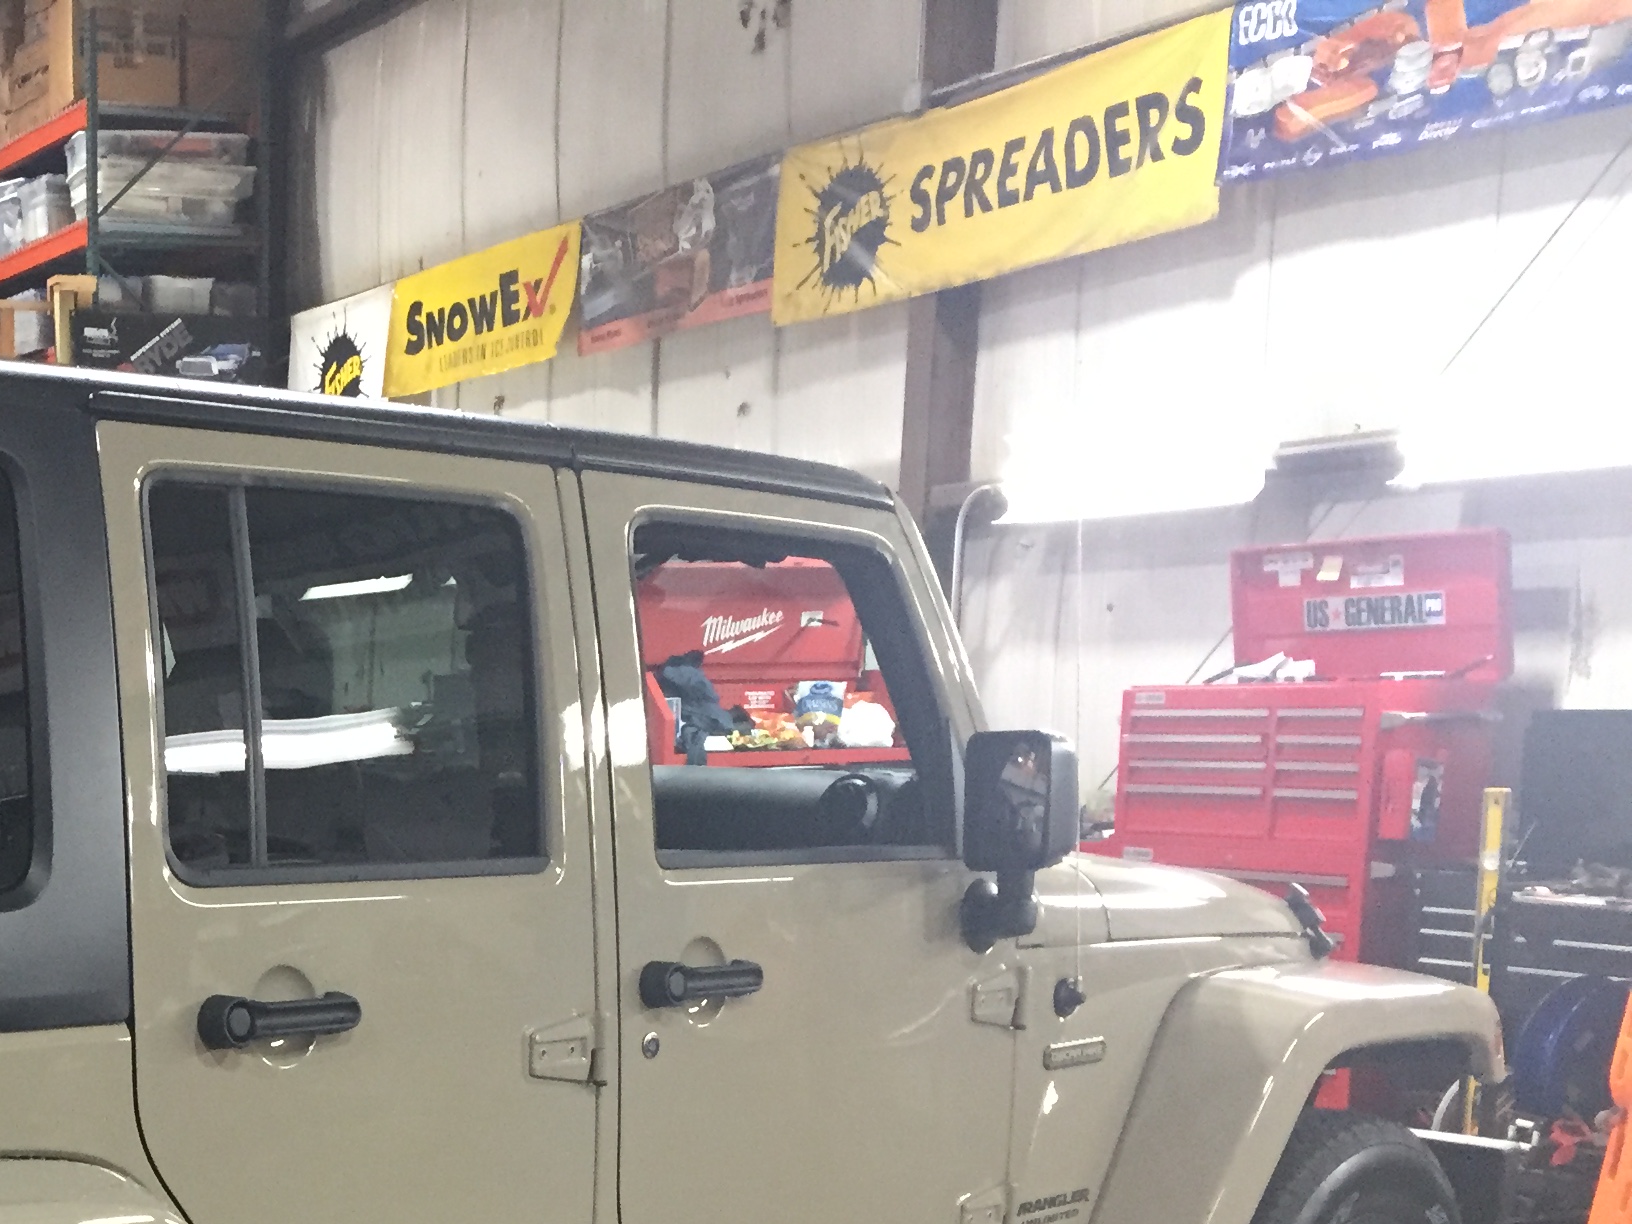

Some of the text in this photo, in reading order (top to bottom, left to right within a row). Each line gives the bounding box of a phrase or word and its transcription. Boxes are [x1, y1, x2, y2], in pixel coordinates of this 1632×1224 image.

[1239, 0, 1298, 45] ECCO
[910, 77, 1206, 233] SPREADERS
[822, 190, 884, 272] FISHER
[701, 607, 784, 648] Milwaukee
[1306, 599, 1330, 628] US
[1344, 593, 1425, 627] GENERAL
